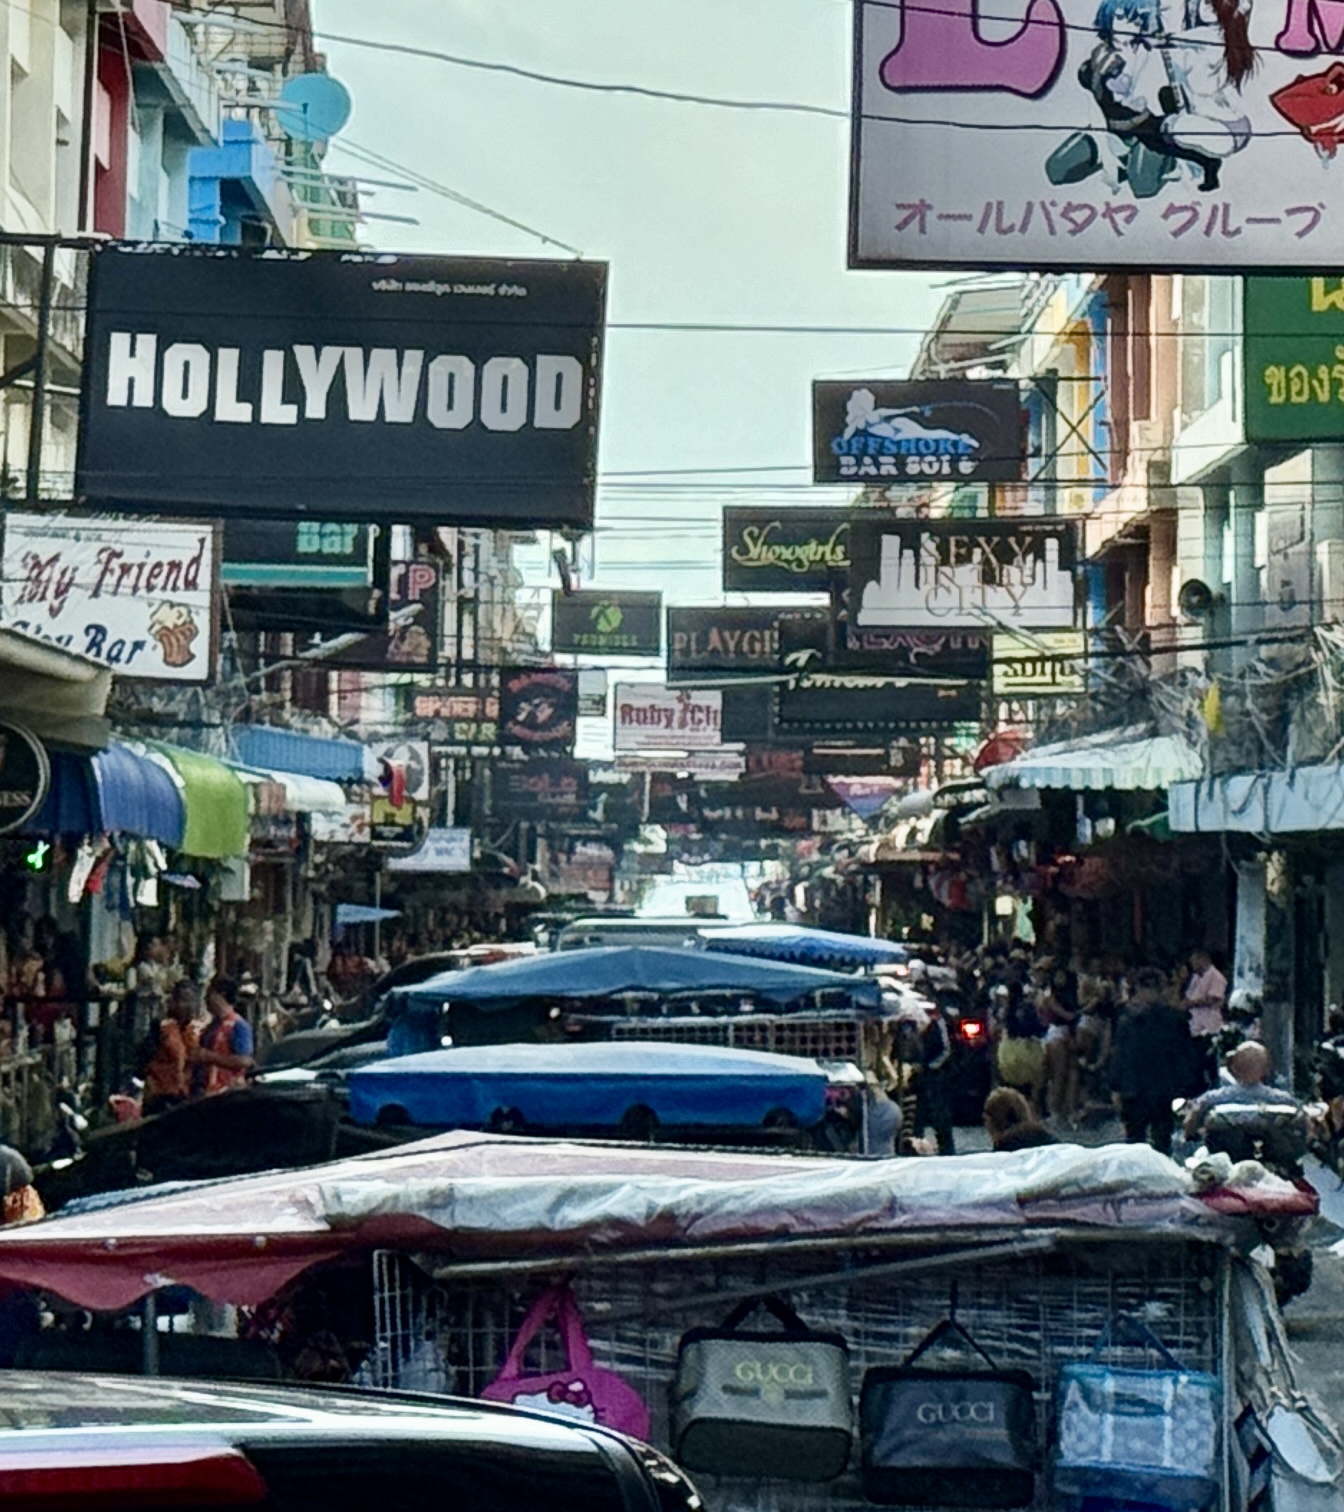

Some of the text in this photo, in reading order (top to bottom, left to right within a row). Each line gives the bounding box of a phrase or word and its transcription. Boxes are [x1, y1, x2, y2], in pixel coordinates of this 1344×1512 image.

[106, 332, 583, 431] HOLLYWOOD
[839, 455, 899, 476] BAR
[731, 520, 851, 572] Showgirls
[12, 537, 207, 619] My Friend
[736, 1360, 813, 1384] GUCCI
[917, 1402, 994, 1424] GUCCI
